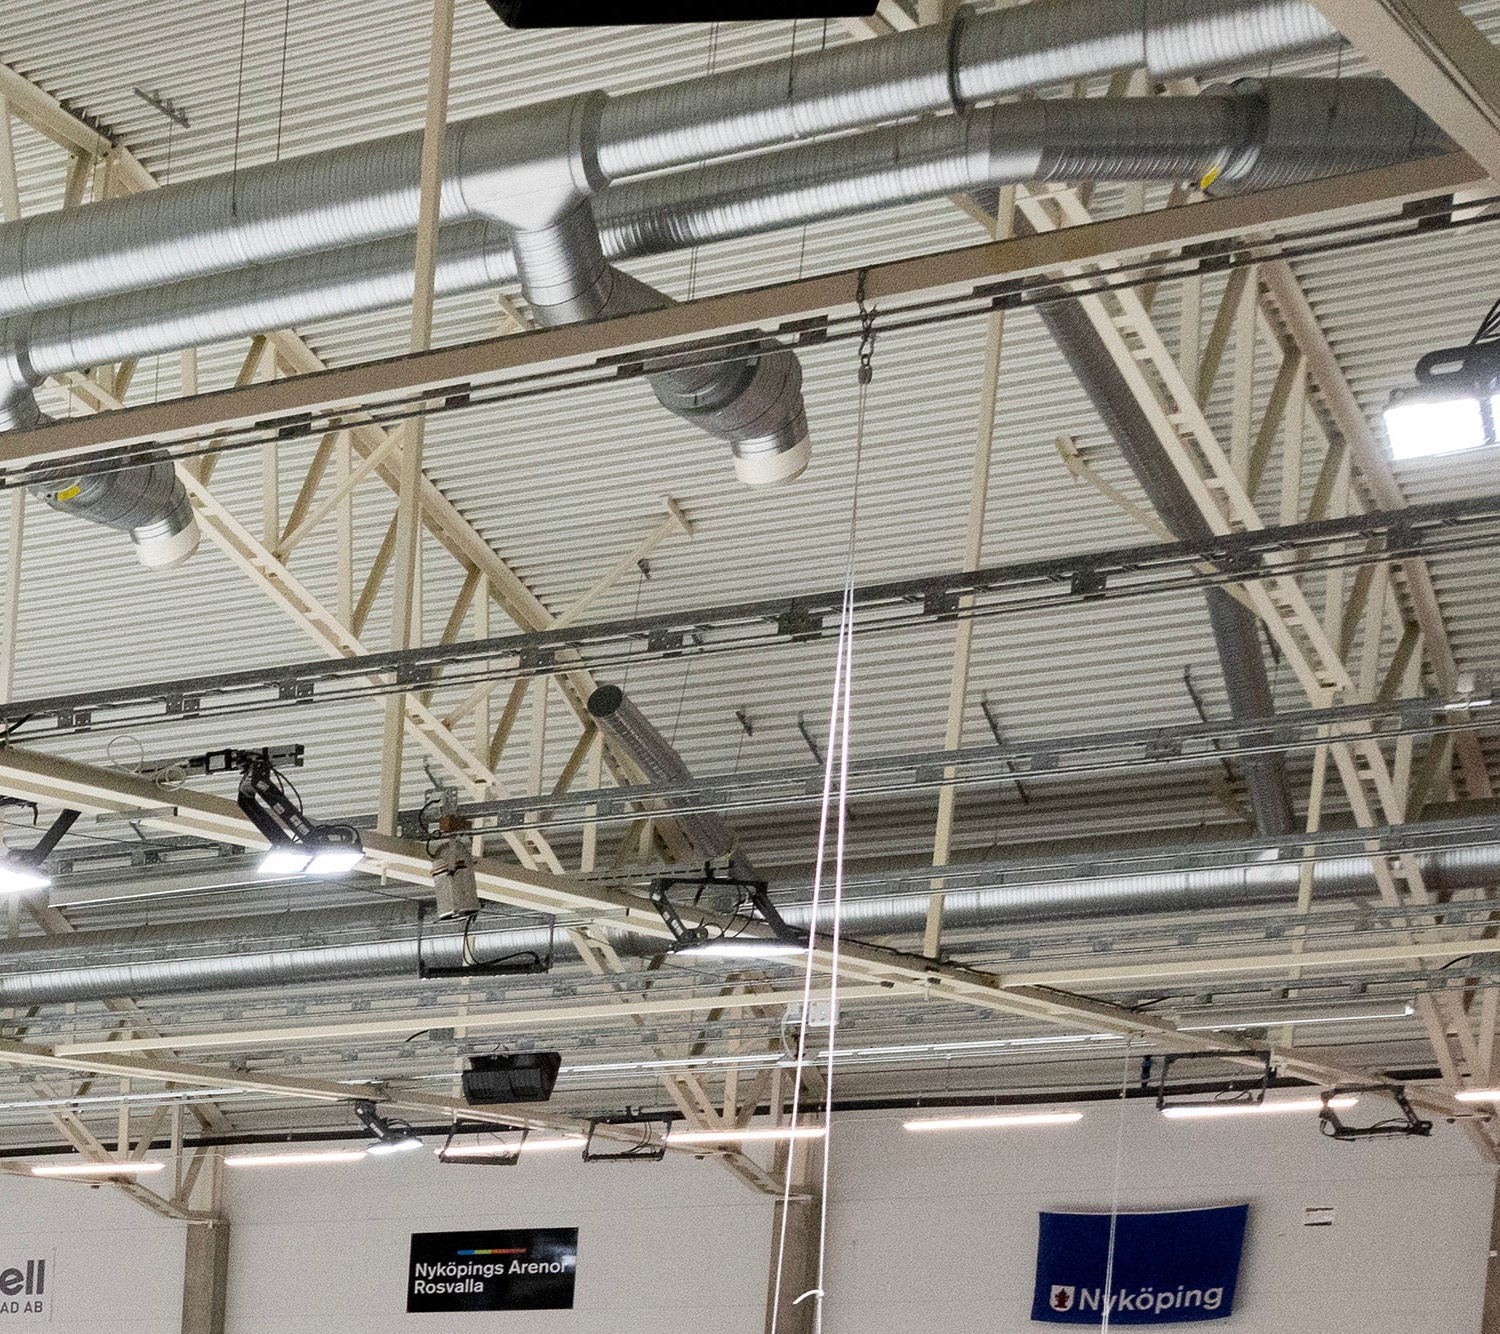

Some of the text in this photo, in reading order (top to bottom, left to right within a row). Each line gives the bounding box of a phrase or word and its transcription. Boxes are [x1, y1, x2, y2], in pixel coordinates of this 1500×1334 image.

[414, 1259, 567, 1280] Nyköpings Arenor
[414, 1278, 484, 1295] Rosvalla
[23, 1301, 43, 1313] AB
[1078, 1285, 1224, 1317] Nyköping
